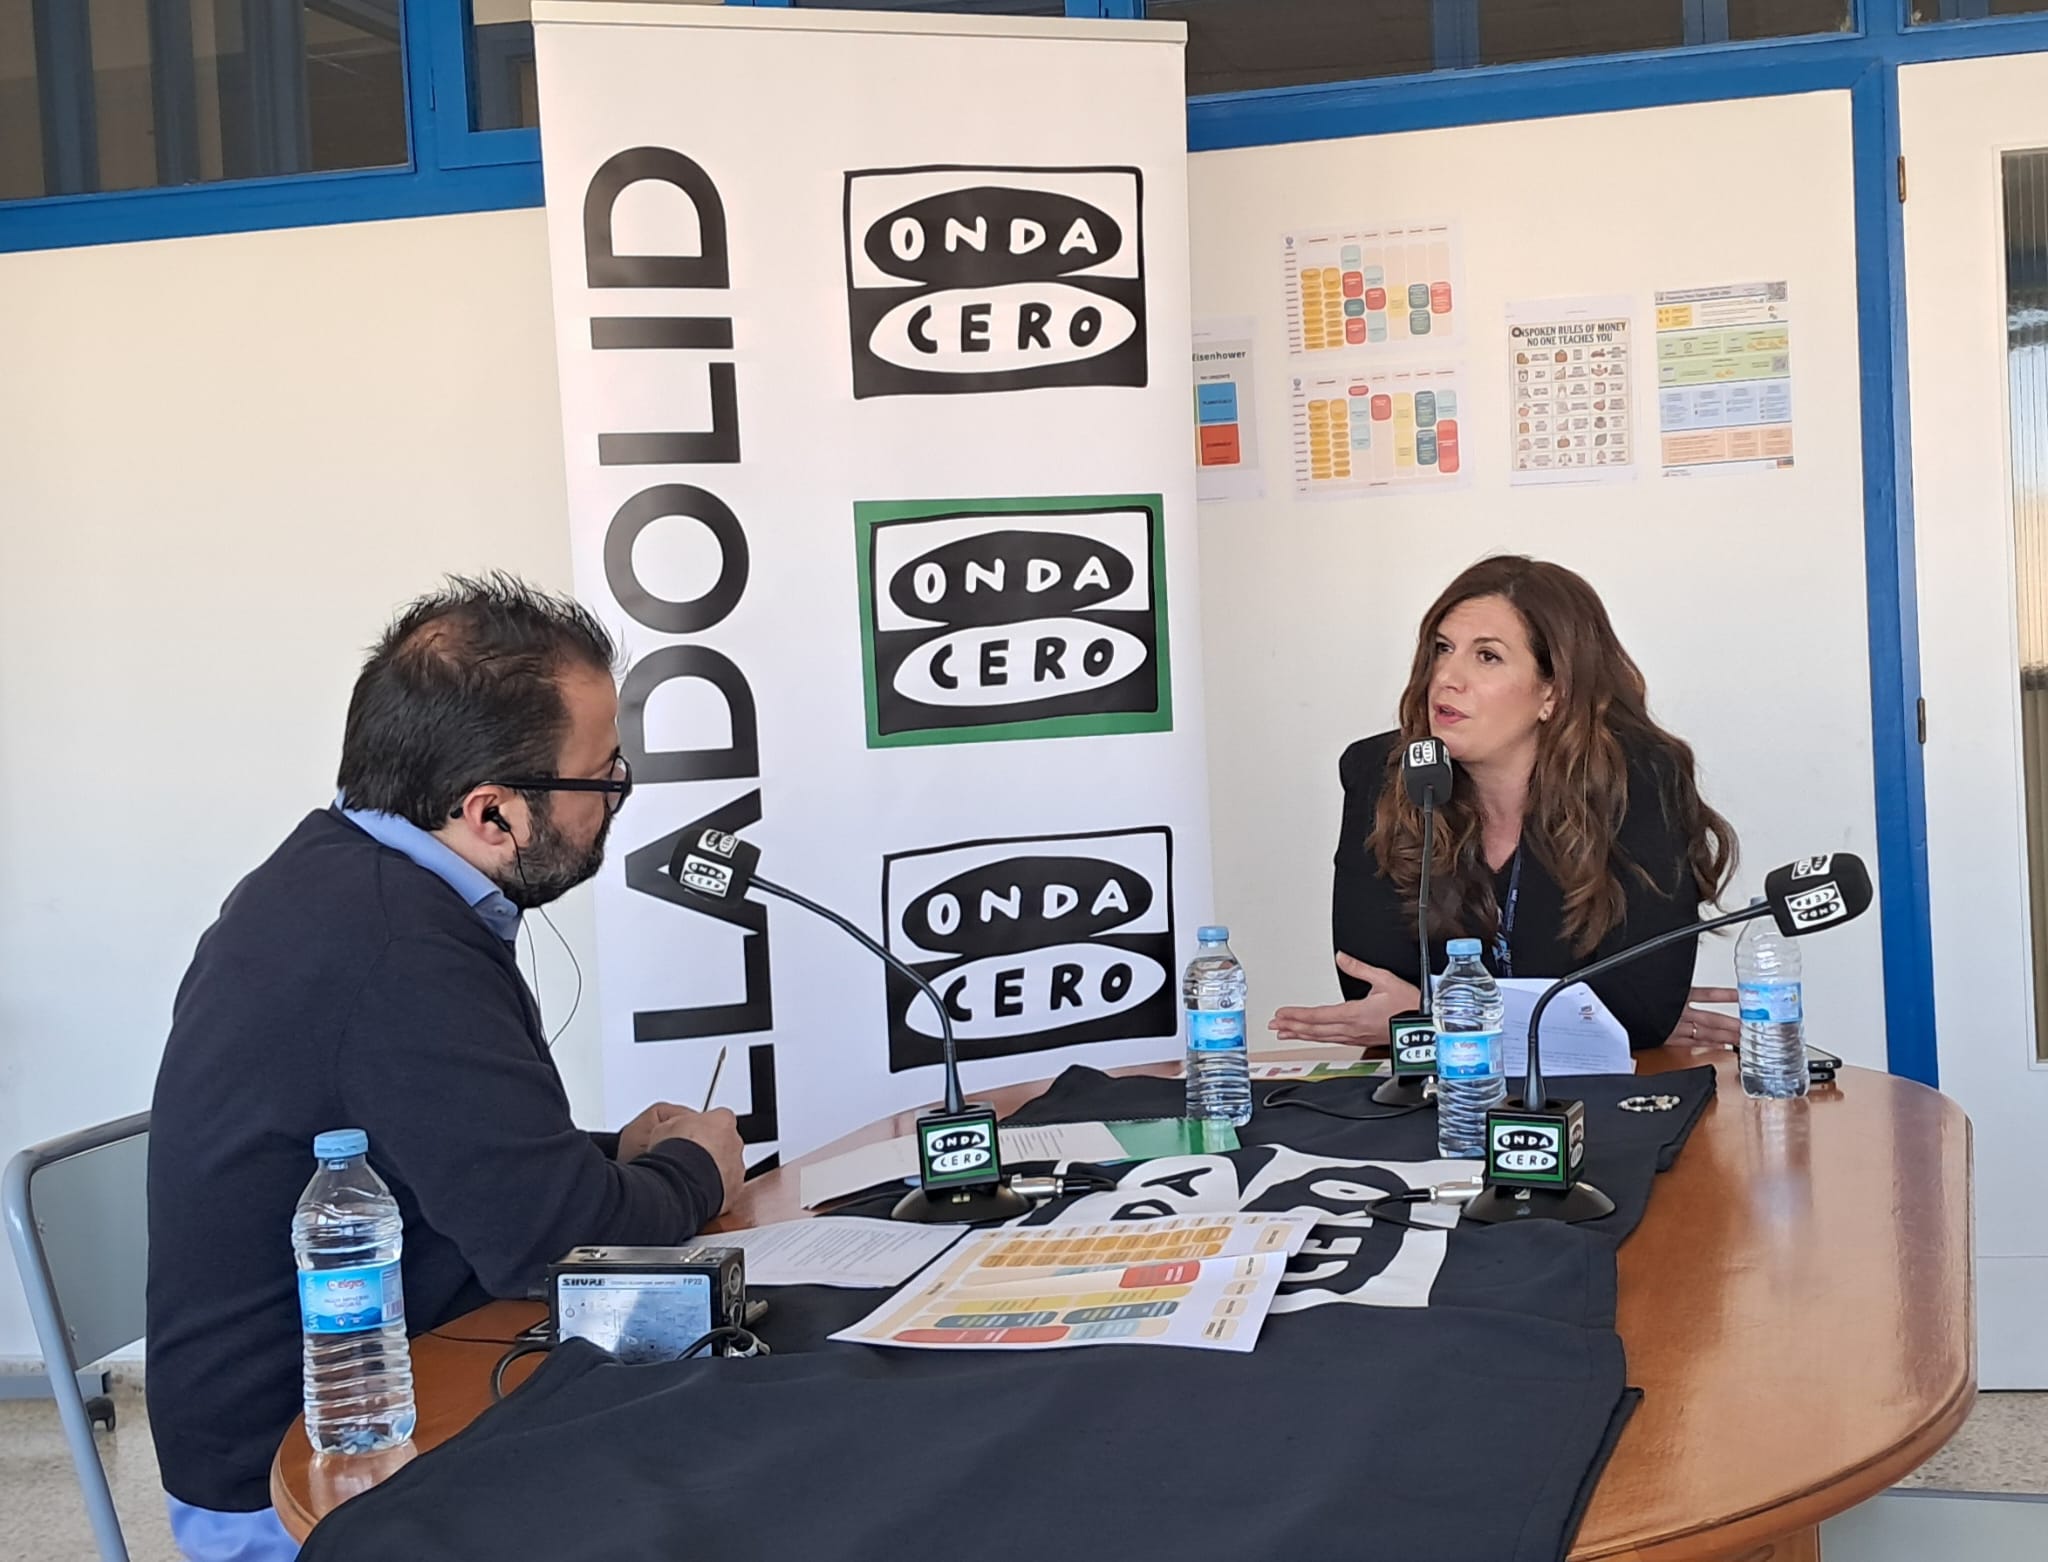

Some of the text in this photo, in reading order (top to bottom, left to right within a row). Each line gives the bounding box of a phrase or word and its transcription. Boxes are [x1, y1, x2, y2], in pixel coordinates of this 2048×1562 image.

[889, 215, 1098, 262] ONDA
[906, 302, 1103, 354] CERO
[1512, 322, 1626, 337] NSPOKEN RULES OF MONEY
[1527, 333, 1613, 346] NO ONE TEACHES YOU
[1192, 351, 1246, 362] Eisenhower
[913, 555, 1111, 604] ONDA
[584, 146, 779, 1180] LLADOLID
[928, 637, 1115, 690] CERO
[690, 863, 724, 880] ONDA
[925, 878, 1129, 932] ONDA
[1801, 902, 1837, 919] ONDA
[943, 962, 1133, 1022] CERO
[1406, 1049, 1437, 1059] CER
[935, 1133, 981, 1150] ONDA
[1501, 1134, 1549, 1147] ONDA
[940, 1153, 982, 1167] CERO
[1505, 1154, 1549, 1166] CERO
[561, 1278, 606, 1287] SHURE
